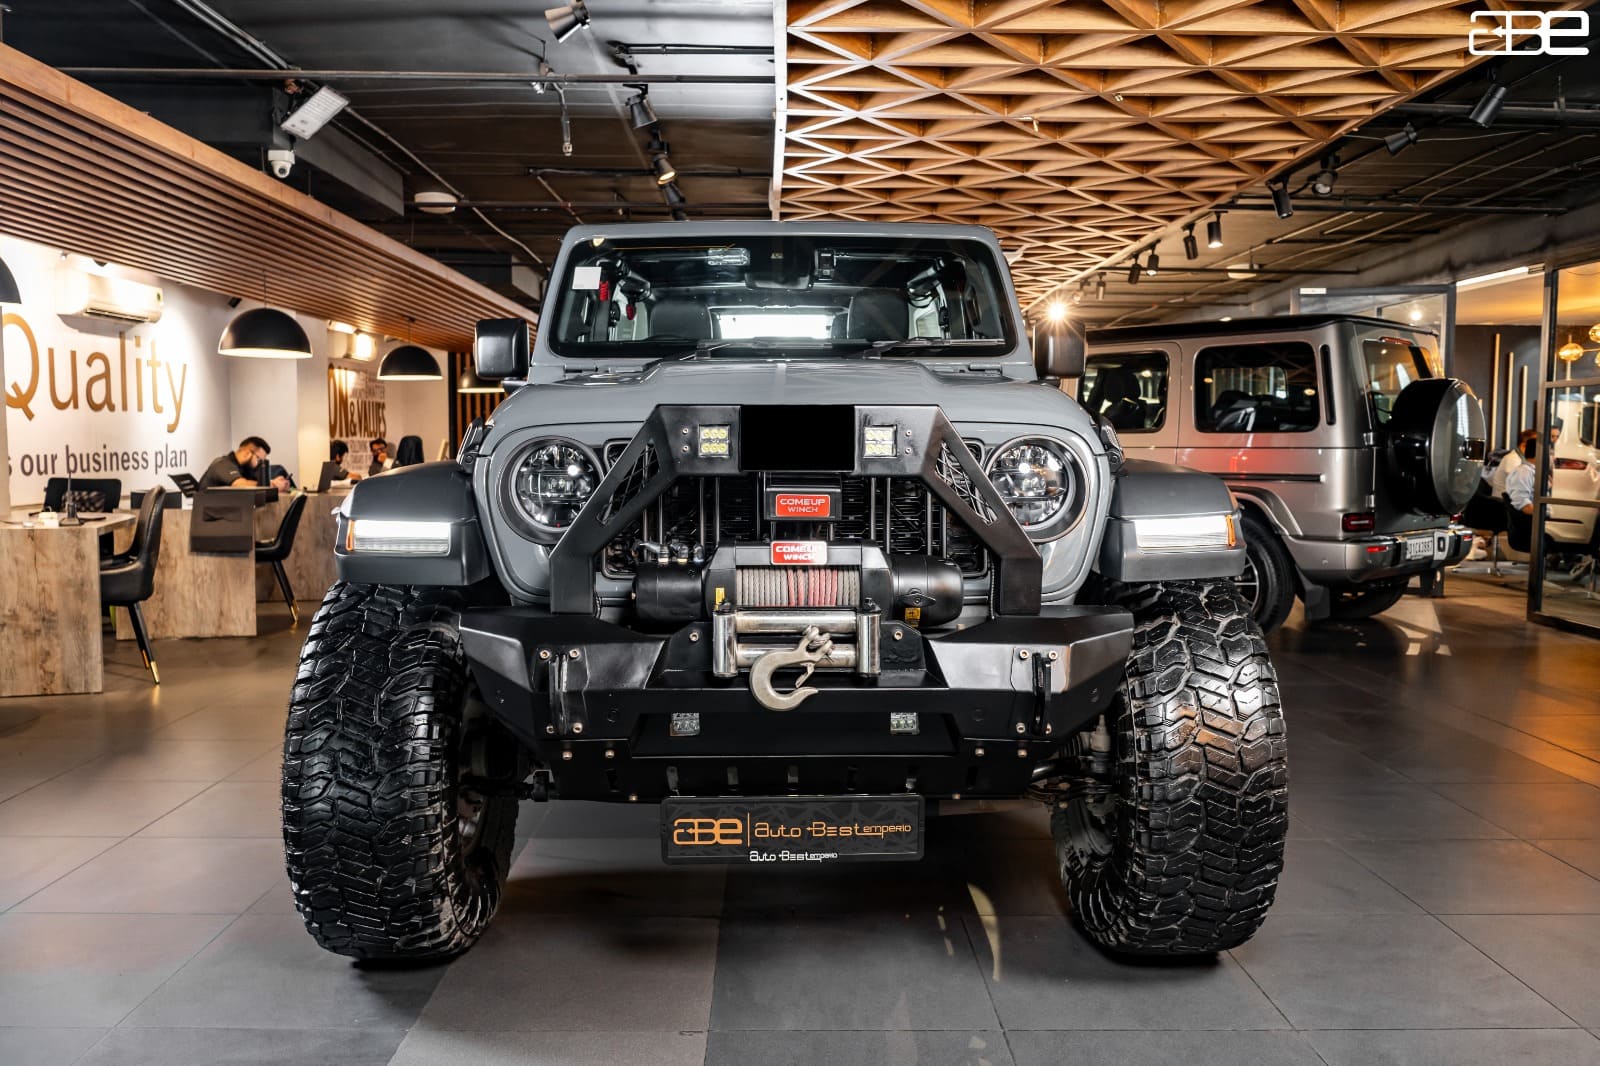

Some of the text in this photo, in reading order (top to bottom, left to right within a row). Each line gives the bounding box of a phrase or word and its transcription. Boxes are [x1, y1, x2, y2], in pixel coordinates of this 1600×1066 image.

[2, 312, 188, 434] Quality
[20, 452, 58, 477] our
[65, 444, 149, 474] business
[154, 443, 188, 475] plan
[775, 545, 823, 553] COMEU
